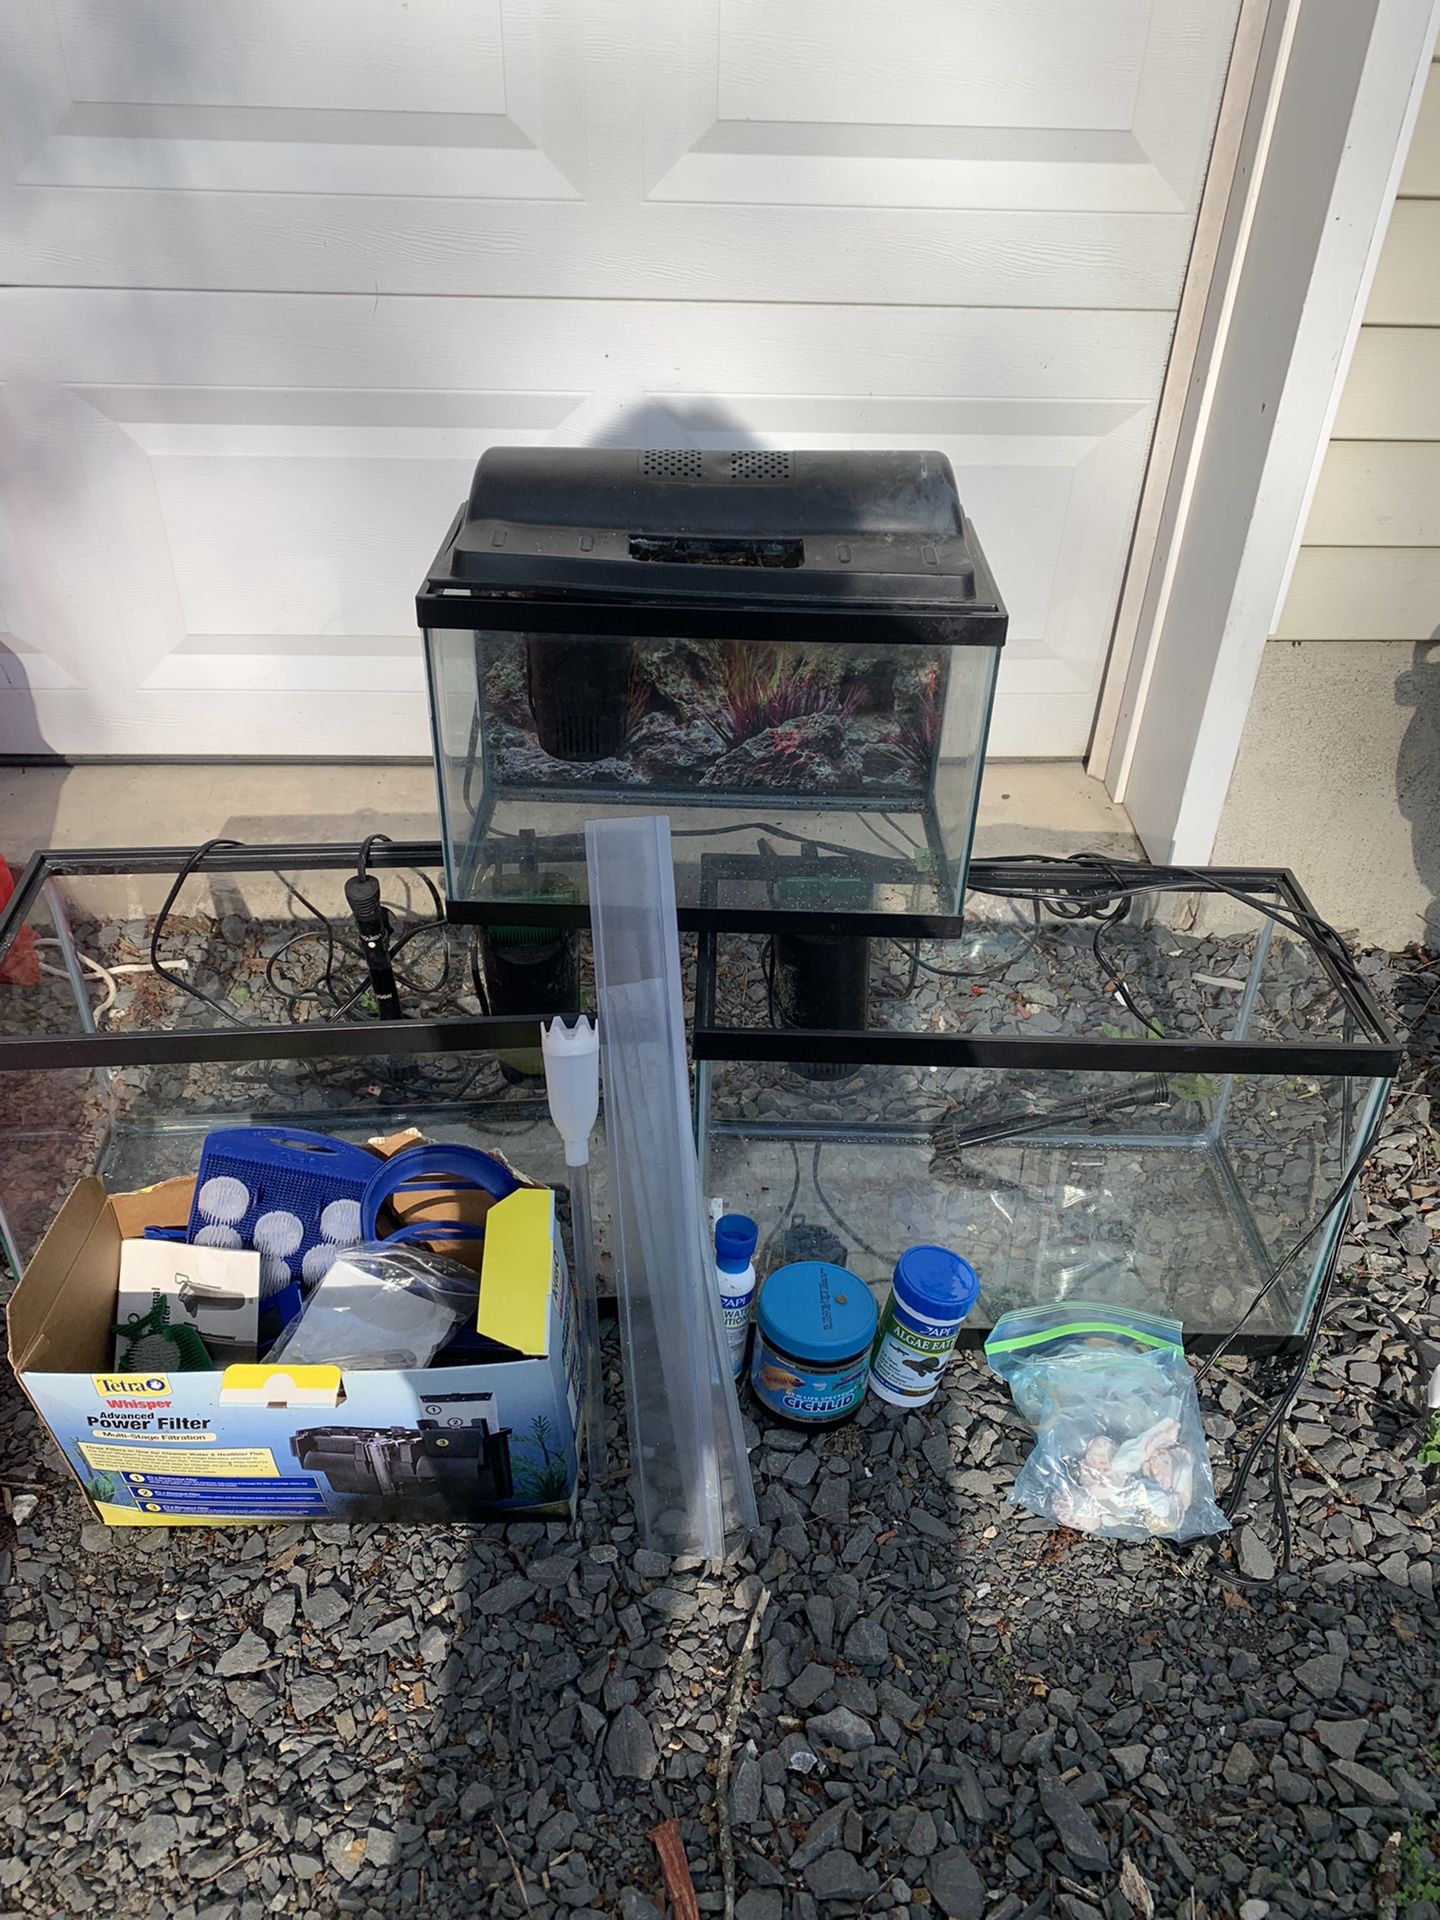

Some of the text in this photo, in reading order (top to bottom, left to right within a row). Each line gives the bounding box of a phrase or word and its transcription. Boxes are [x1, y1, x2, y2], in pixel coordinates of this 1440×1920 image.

[725, 1297, 746, 1307] API
[929, 1327, 951, 1336] API
[893, 1326, 929, 1350] ALGAE
[97, 1379, 147, 1392] Tetra
[106, 1400, 172, 1410] Whisper
[783, 1393, 855, 1412] CICHLID
[100, 1412, 155, 1420] Advanced
[87, 1416, 211, 1430] Power Filter
[102, 1431, 206, 1441] Multi-Stage Filtration
